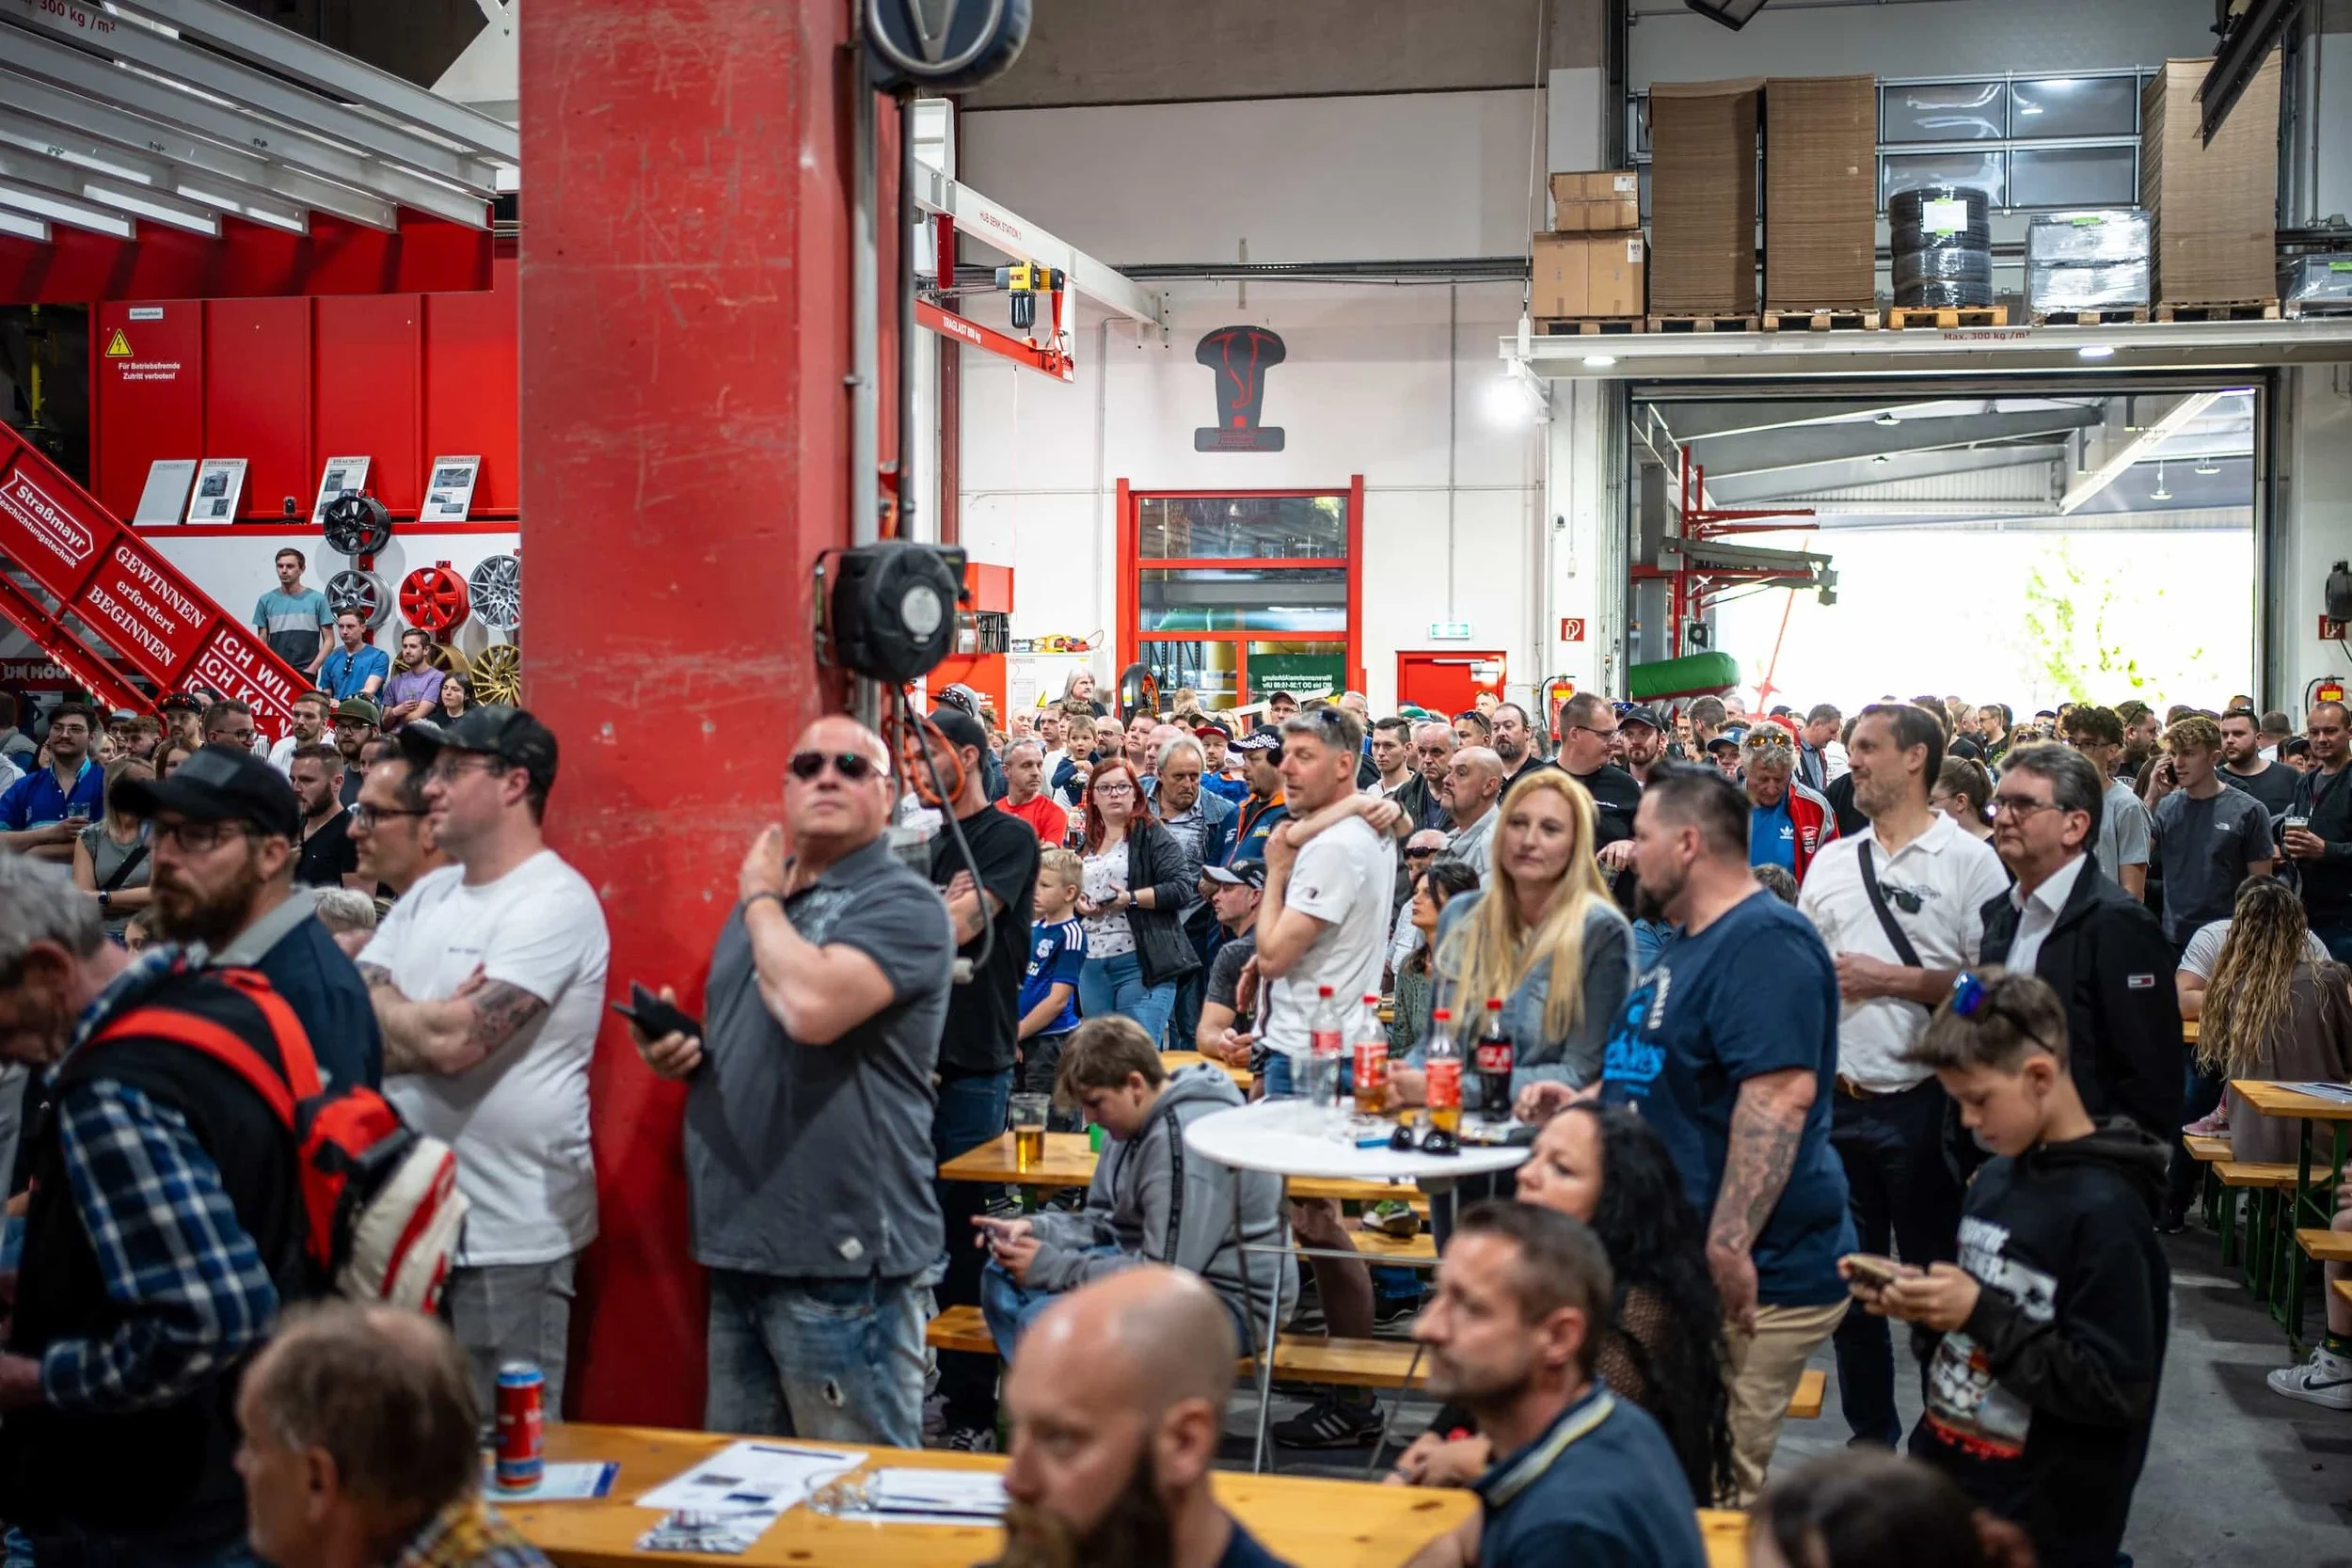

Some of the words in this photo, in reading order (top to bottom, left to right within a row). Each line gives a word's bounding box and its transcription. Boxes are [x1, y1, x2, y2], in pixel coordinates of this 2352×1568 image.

[40, 0, 65, 16] 300
[70, 7, 86, 27] kg
[1994, 331, 2006, 341] kg
[16, 485, 86, 548] Straßmayr
[115, 546, 207, 629] GEWINNEN
[117, 580, 176, 635] erfordert
[87, 584, 177, 667] BEGINNEN
[199, 652, 236, 689] ICH
[215, 628, 254, 669] ICH
[256, 663, 294, 711] WIL
